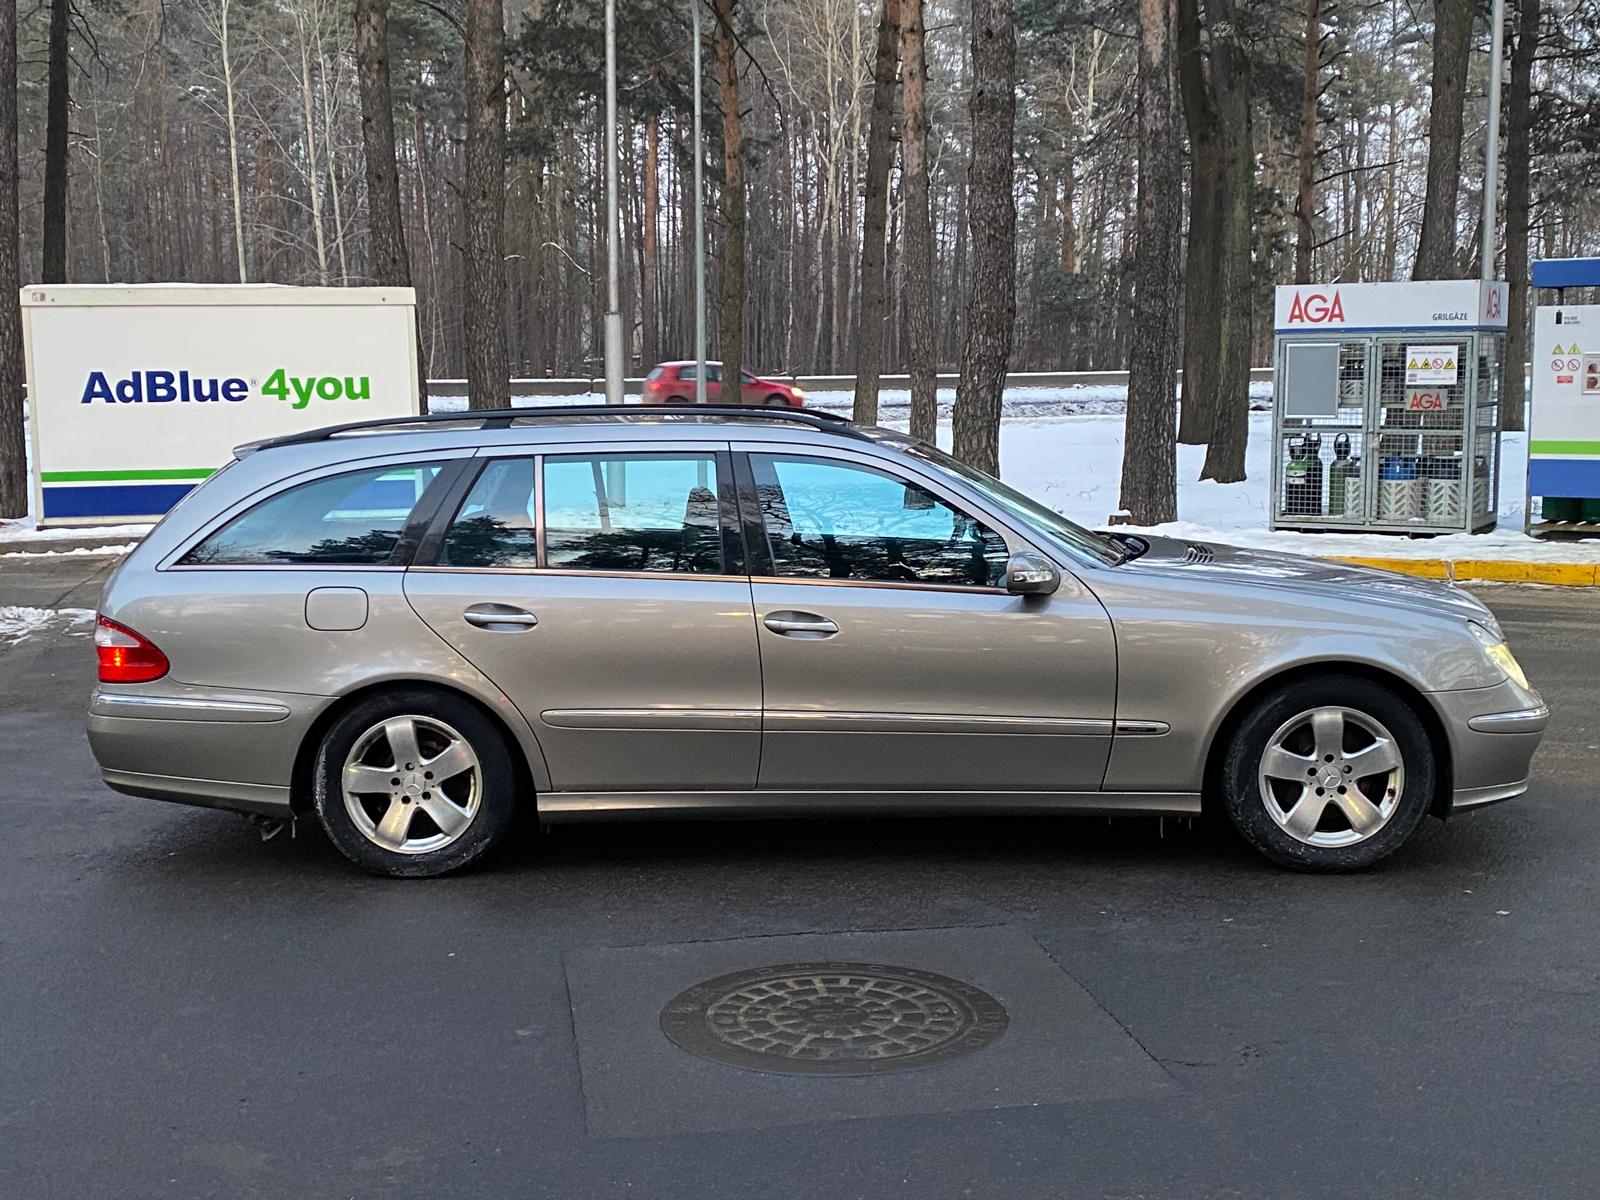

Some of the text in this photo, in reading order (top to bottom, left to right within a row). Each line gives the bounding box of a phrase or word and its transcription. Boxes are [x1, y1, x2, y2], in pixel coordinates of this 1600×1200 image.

[1288, 289, 1345, 323] AGA
[1486, 287, 1501, 319] AGA
[261, 369, 371, 410] 4you
[1410, 391, 1443, 409] AGA
